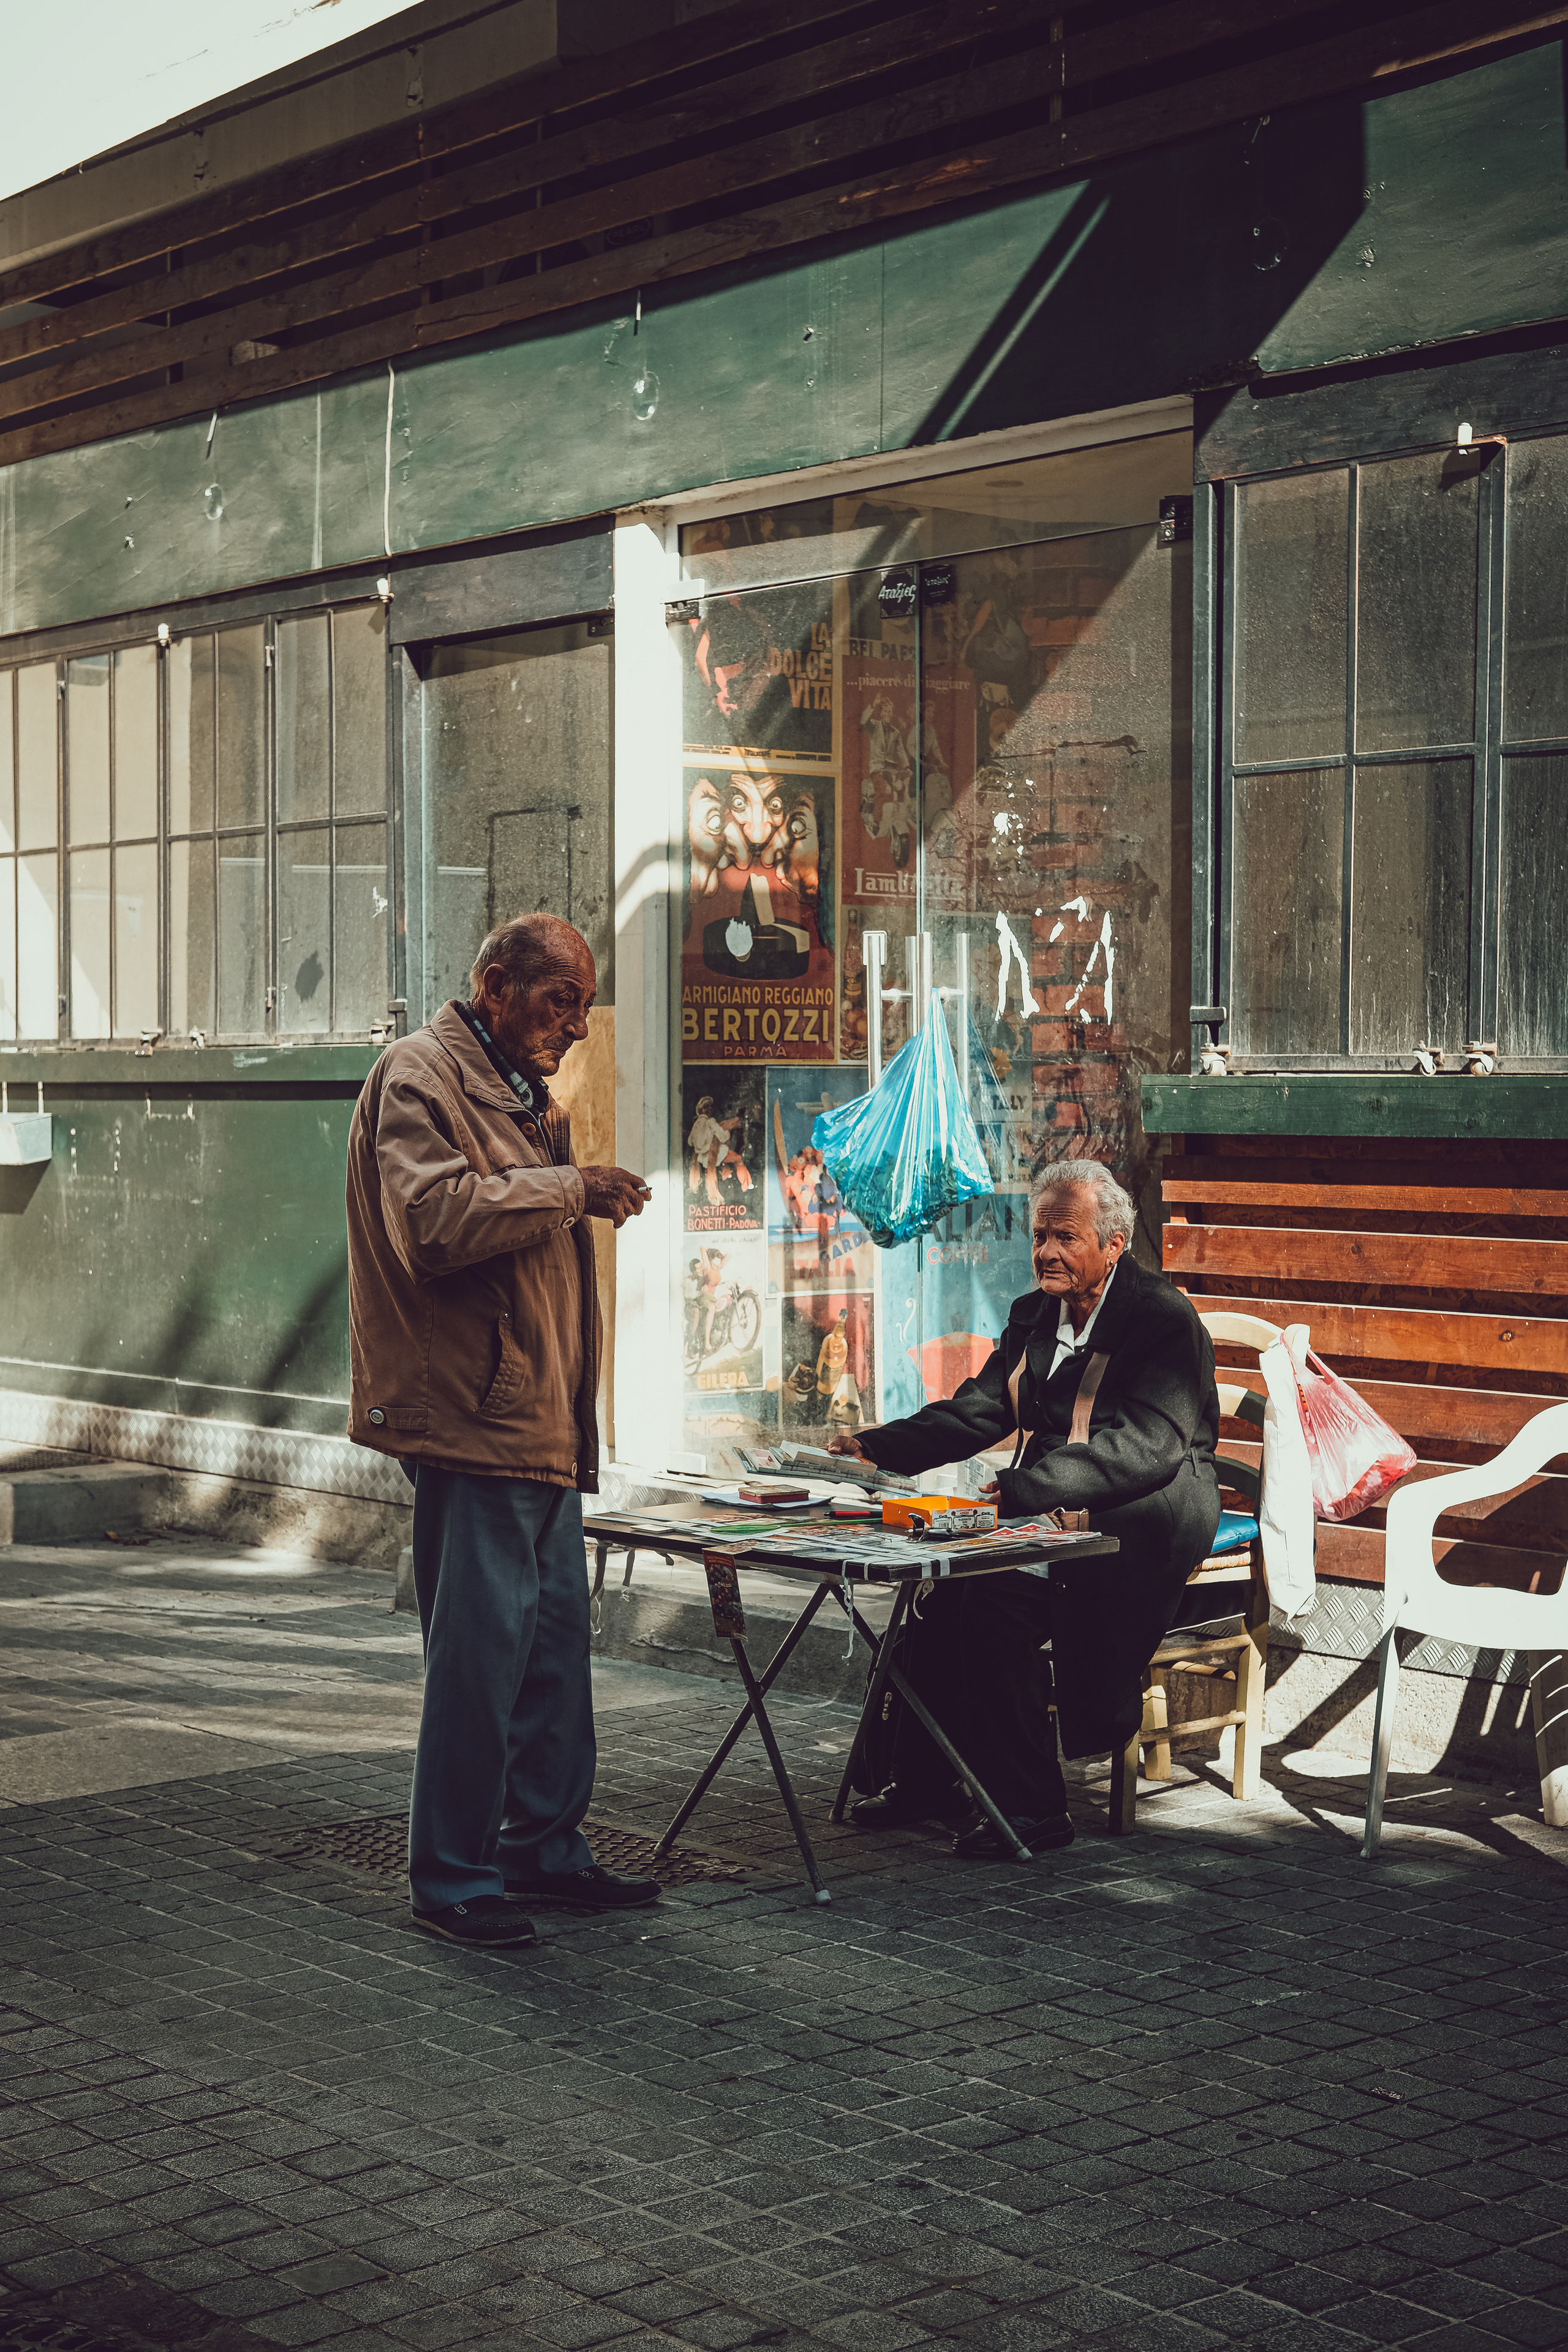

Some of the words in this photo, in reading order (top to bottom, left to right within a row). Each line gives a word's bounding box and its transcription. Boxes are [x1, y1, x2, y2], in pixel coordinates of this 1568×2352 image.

[812, 622, 831, 650] LA
[881, 642, 916, 662] PAES
[768, 646, 832, 682] DOLCE
[788, 678, 832, 710] VITA
[925, 675, 971, 695] iaggiare
[682, 1008, 829, 1042] BERTOZZI
[724, 1046, 787, 1057] PARMA
[688, 1204, 747, 1216] PASTIFICIO
[789, 1257, 856, 1279] ITALIA
[696, 1371, 750, 1389] GILERA
